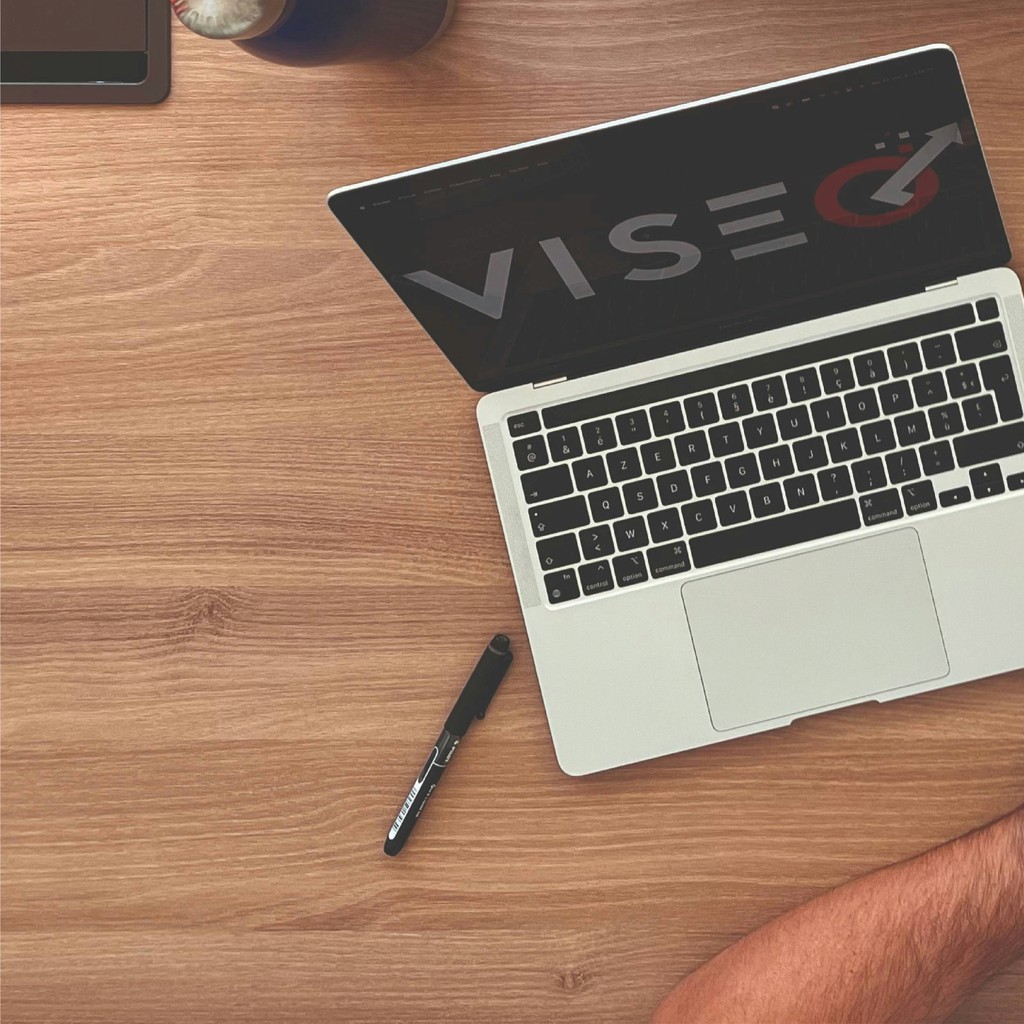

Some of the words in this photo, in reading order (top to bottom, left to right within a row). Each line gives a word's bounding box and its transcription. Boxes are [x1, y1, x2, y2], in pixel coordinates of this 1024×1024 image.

[586, 469, 594, 478] A
[620, 460, 627, 470] Z
[654, 452, 661, 462] E
[688, 444, 696, 453] R
[722, 435, 728, 444] T
[756, 426, 763, 436] Y
[790, 418, 798, 428] U
[858, 401, 866, 411] O
[892, 393, 899, 403] P
[602, 500, 610, 510] Q
[636, 492, 644, 501] S
[670, 484, 678, 493] D
[704, 475, 710, 484] F
[738, 466, 746, 476] G
[772, 458, 781, 467] H
[808, 450, 814, 459] J
[840, 441, 848, 450] K
[874, 434, 881, 443] L
[907, 424, 916, 434] M
[586, 579, 609, 591] control
[622, 572, 643, 582] option
[655, 560, 686, 574] command
[867, 508, 898, 522] command
[910, 501, 931, 511] option
[625, 529, 635, 539] W
[661, 521, 669, 530] X
[695, 512, 703, 522] C
[729, 504, 736, 513] V
[763, 496, 771, 505] B
[797, 487, 805, 496] N
[830, 473, 836, 482] ?
